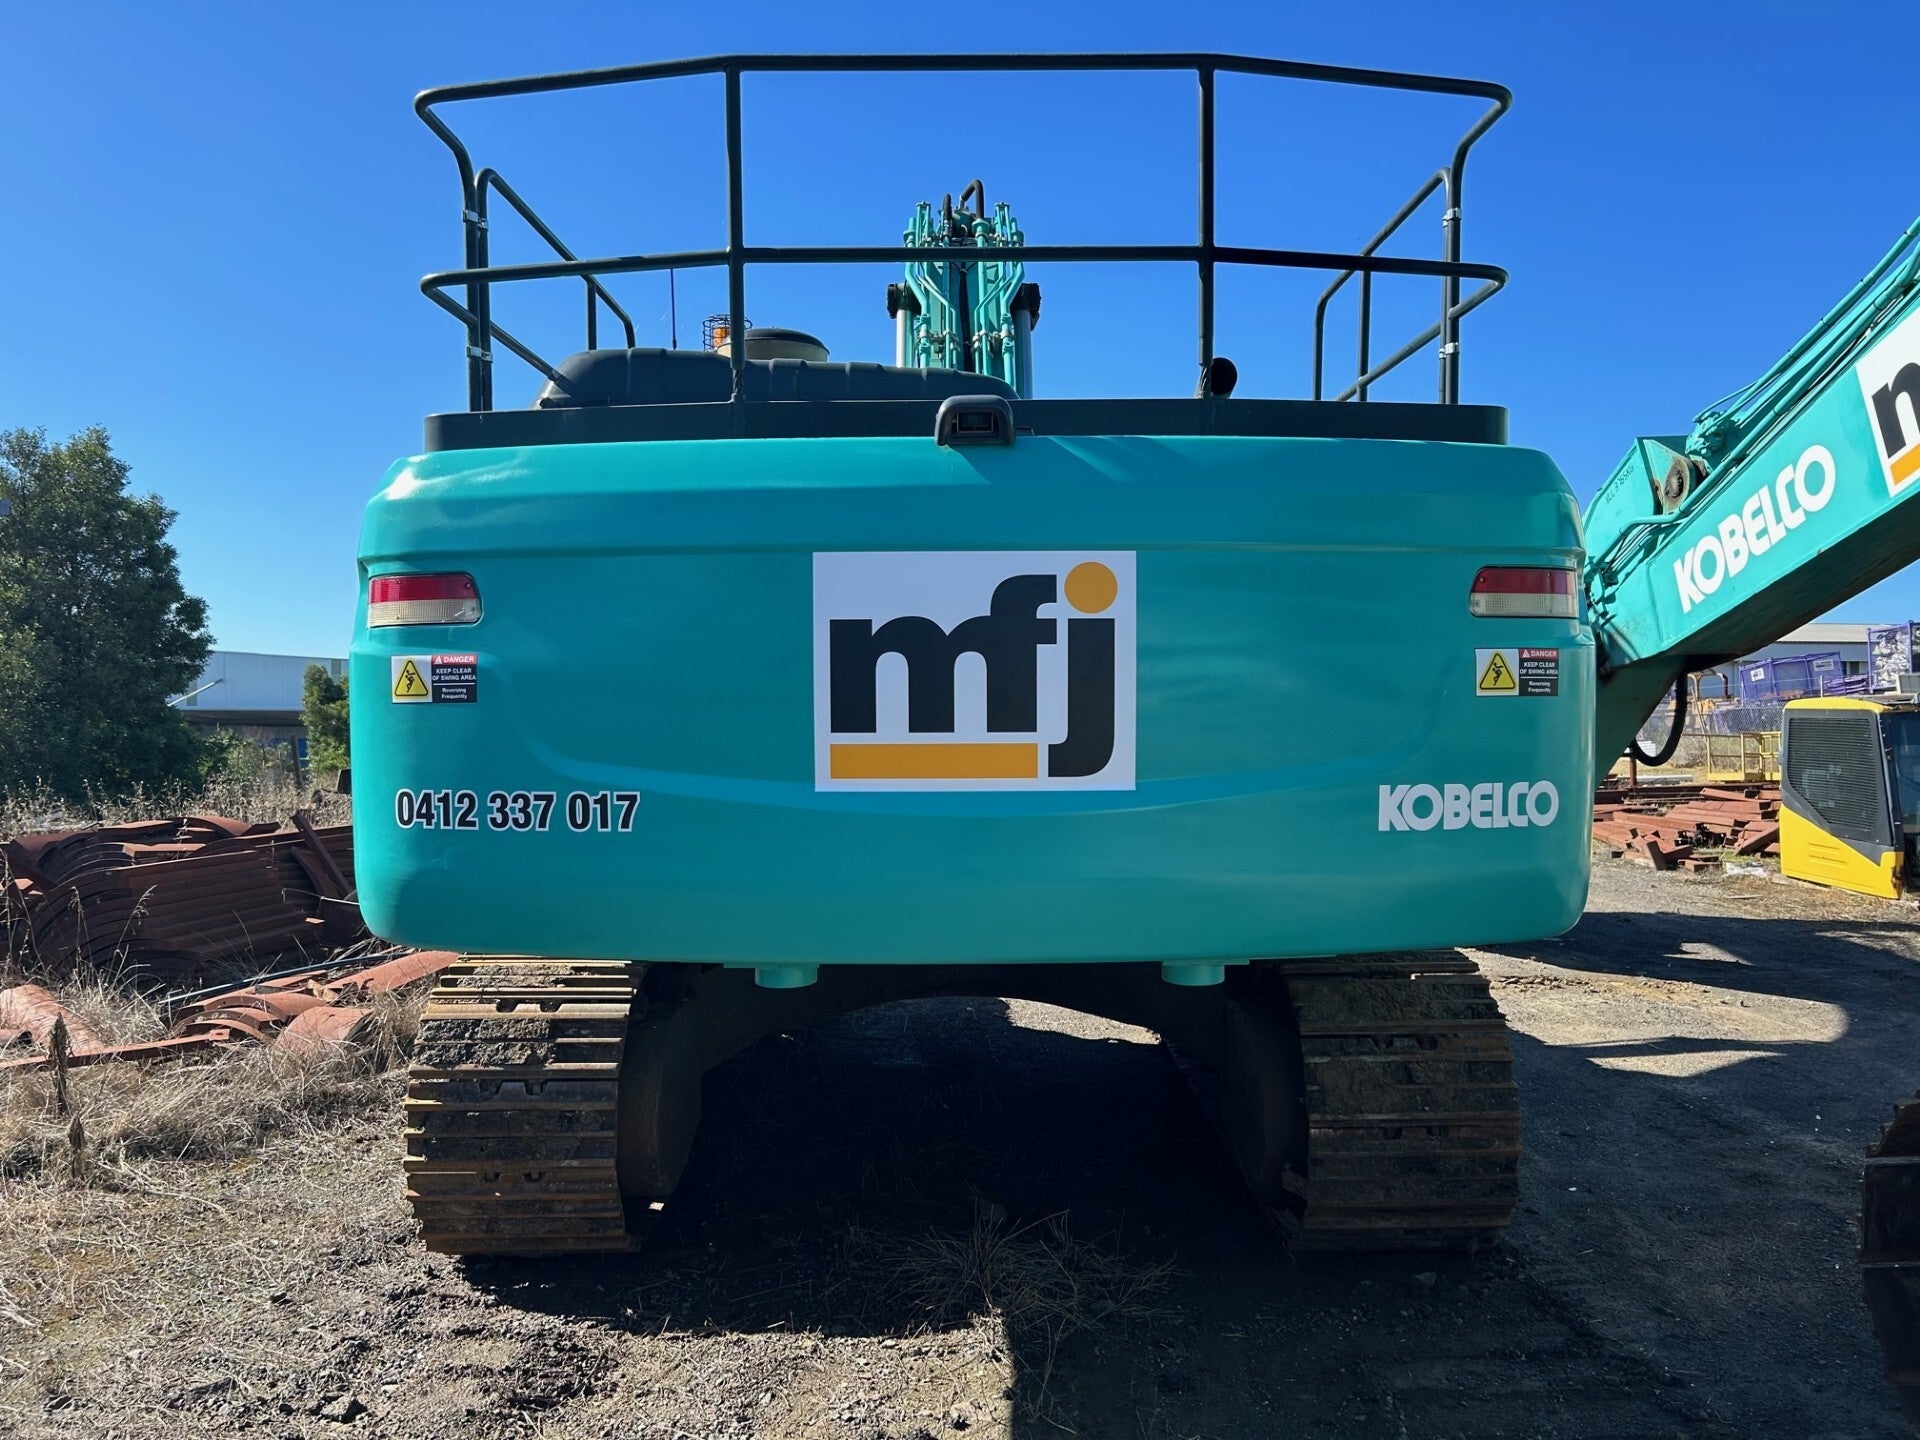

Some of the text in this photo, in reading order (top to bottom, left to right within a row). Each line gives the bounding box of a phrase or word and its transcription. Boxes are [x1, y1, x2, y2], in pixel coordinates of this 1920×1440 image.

[1673, 445, 1836, 614] KOBELCO
[443, 655, 475, 663] DANGER
[829, 561, 1118, 777] mfj
[395, 788, 640, 832] 0412 337 017
[1378, 780, 1560, 832] KOBELCO
